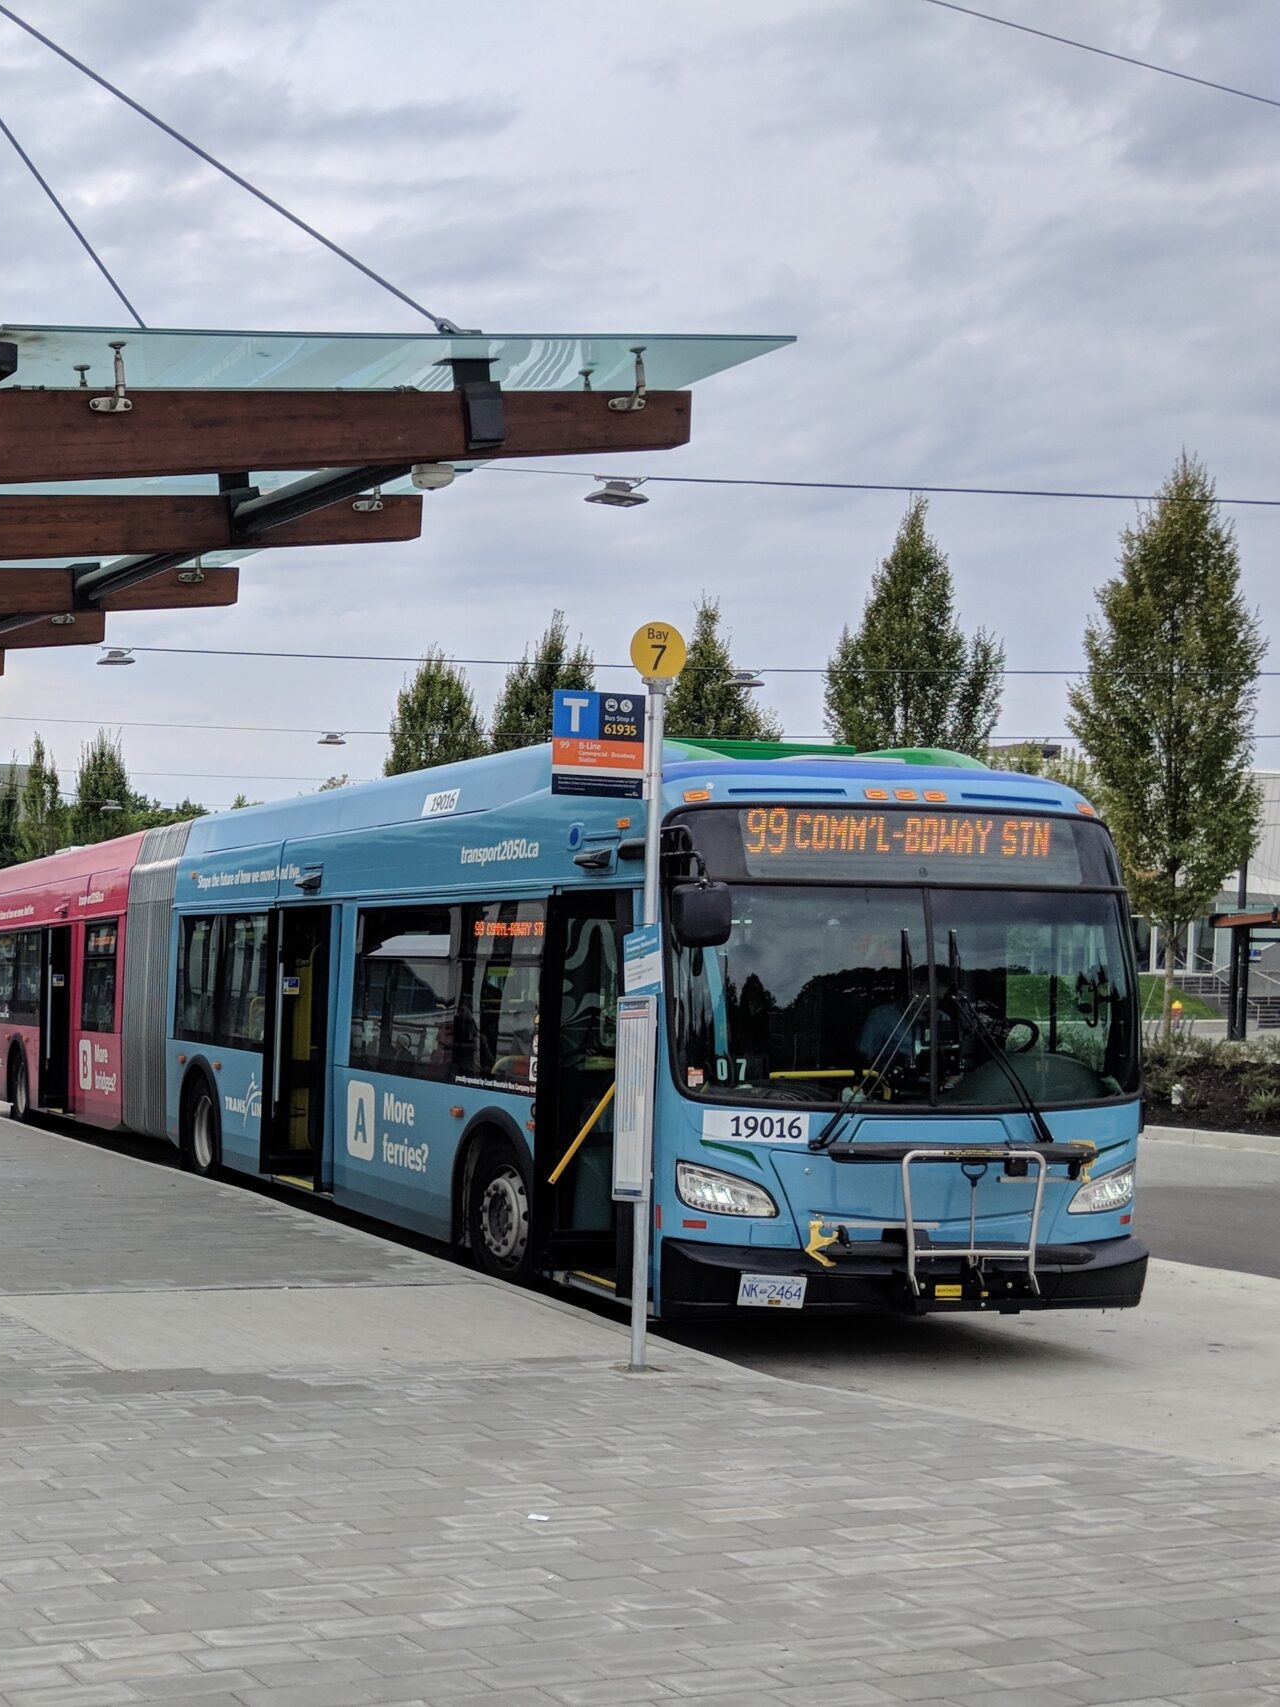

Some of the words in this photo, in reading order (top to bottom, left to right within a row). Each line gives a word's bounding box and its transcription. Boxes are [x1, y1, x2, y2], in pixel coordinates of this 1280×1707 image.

[648, 628, 669, 643] Bay
[651, 645, 666, 671] 7
[563, 698, 589, 732] T
[604, 724, 636, 736] 61935
[560, 741, 570, 749] 99
[579, 742, 600, 750] B-Line
[430, 792, 456, 812] 19016
[746, 807, 789, 854] 99
[1002, 821, 1050, 857] STN
[461, 839, 539, 867] transport2050.ca
[198, 874, 211, 891] Shape
[220, 872, 233, 886] future
[234, 870, 241, 884] of
[240, 870, 250, 884] how
[251, 872, 259, 883] we
[276, 864, 288, 880] And
[95, 1044, 108, 1063] More
[95, 1071, 116, 1095] bridges?
[354, 1098, 367, 1144] A
[383, 1092, 414, 1126] More
[731, 1115, 802, 1138] 19016
[383, 1133, 429, 1173] ferries?
